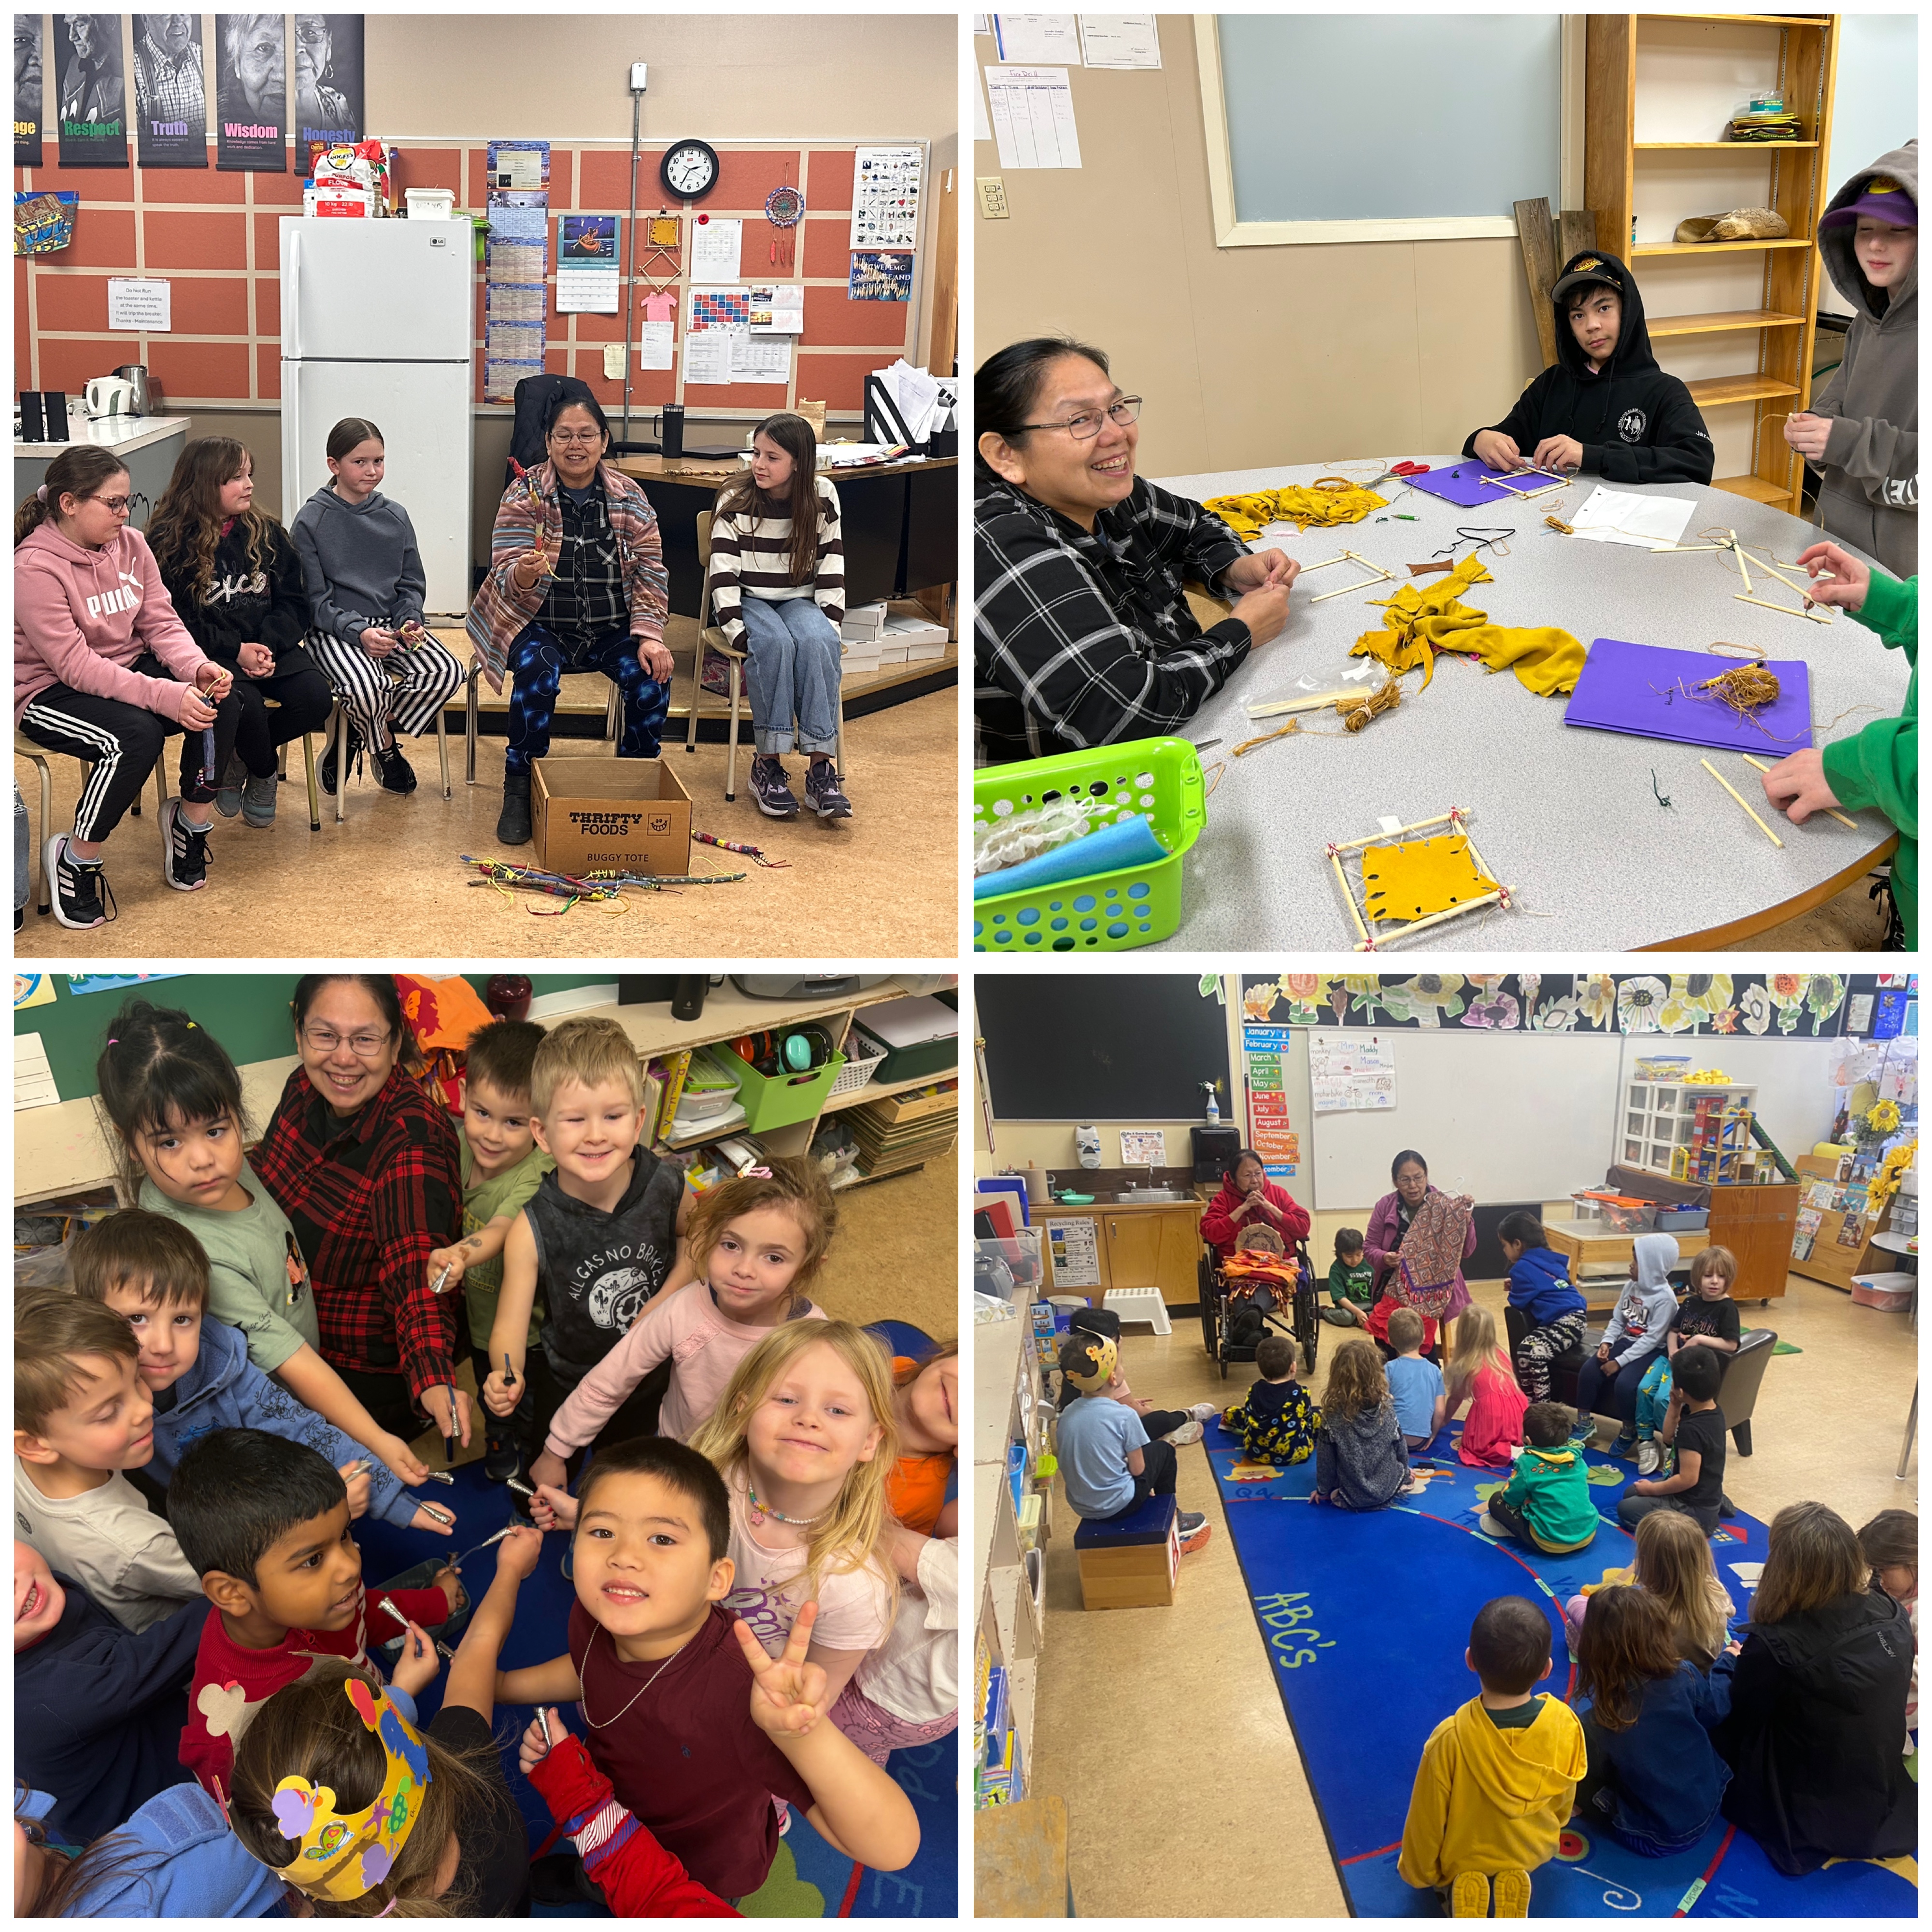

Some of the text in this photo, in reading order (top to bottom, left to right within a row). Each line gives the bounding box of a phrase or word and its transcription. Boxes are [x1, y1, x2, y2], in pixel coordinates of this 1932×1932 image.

[64, 121, 119, 137] Respect
[151, 120, 188, 136] Truth
[225, 123, 278, 138] Wisdom
[303, 127, 355, 142] Honesty
[86, 584, 140, 618] PUMA
[569, 812, 642, 824] THRIFTY
[581, 824, 628, 835] FOODS
[587, 853, 649, 862] BUGGY TOTE
[1247, 1028, 1275, 1037] January
[1246, 1040, 1278, 1050] February
[1360, 1044, 1378, 1055] Maddy
[1311, 1047, 1331, 1055] monkey
[1252, 1067, 1269, 1076] April
[1315, 1089, 1342, 1097] motorbike
[1318, 1099, 1336, 1108] magnet
[1256, 1106, 1269, 1114] July
[1257, 1119, 1281, 1127] August
[1256, 1131, 1290, 1141] September
[1256, 1140, 1284, 1150] October
[606, 1245, 631, 1262] NO
[576, 1255, 604, 1279] GAS
[568, 1281, 585, 1301] ALL
[1254, 1592, 1336, 1669] ABC's
[1683, 1884, 1702, 1906] Paisley
